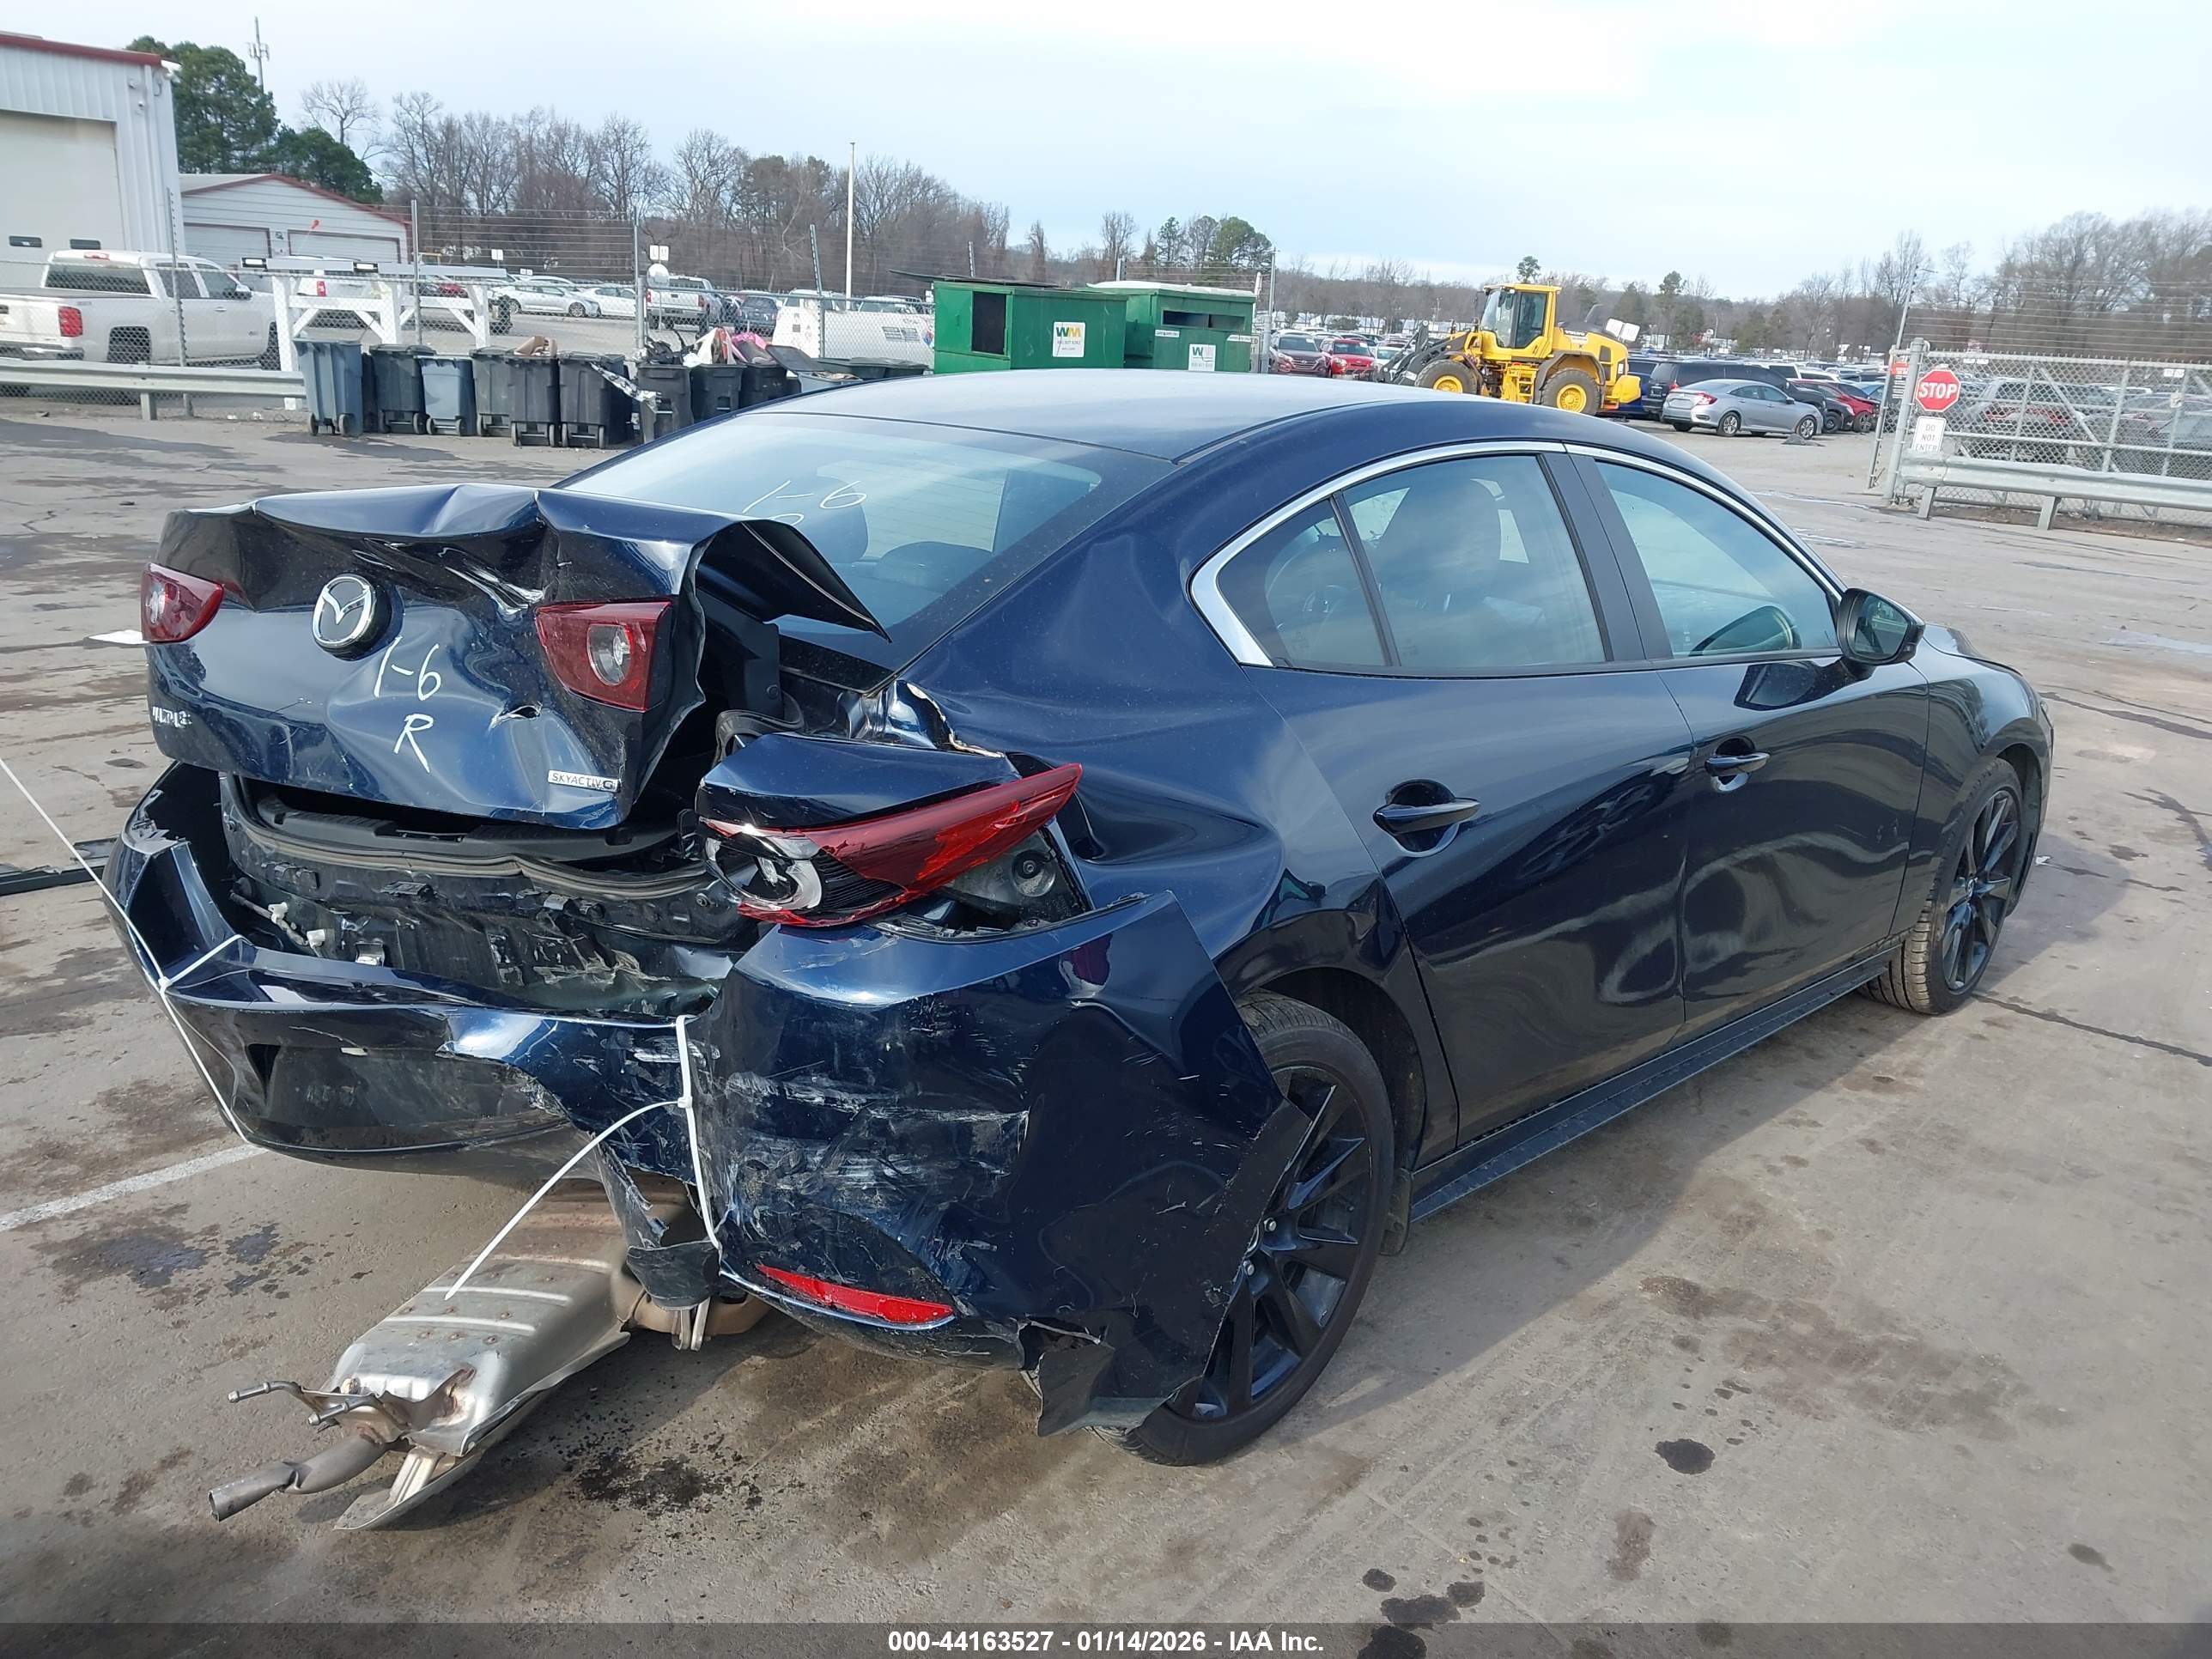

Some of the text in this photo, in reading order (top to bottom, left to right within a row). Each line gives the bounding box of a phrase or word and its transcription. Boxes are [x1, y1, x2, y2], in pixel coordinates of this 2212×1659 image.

[1055, 326, 1081, 337] WM
[1918, 381, 1958, 399] STOP
[1915, 443, 1937, 453] ENTER
[374, 635, 441, 701] 1-6
[393, 713, 434, 773] R
